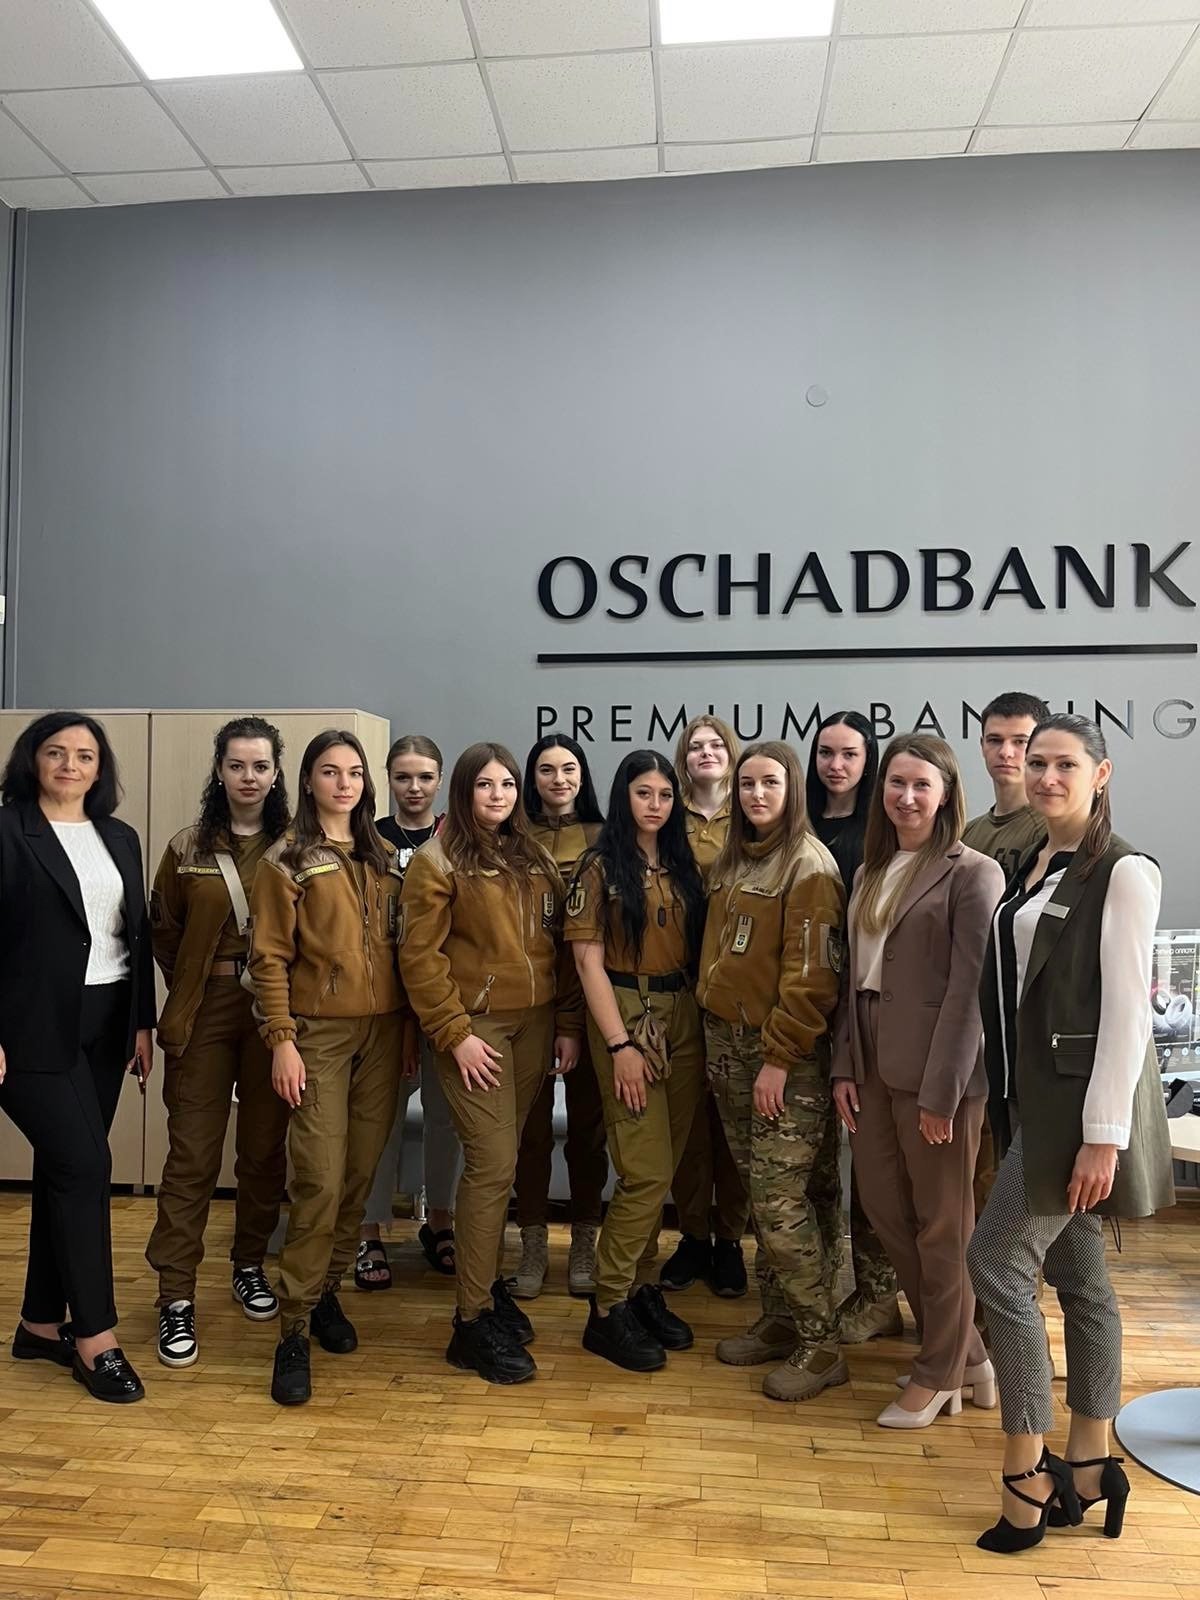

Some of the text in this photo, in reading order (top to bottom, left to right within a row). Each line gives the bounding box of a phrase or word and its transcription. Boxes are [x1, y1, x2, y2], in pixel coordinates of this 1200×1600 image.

[537, 541, 1197, 620] OSCHADBANK
[537, 698, 1197, 742] PREMUM BANNG
